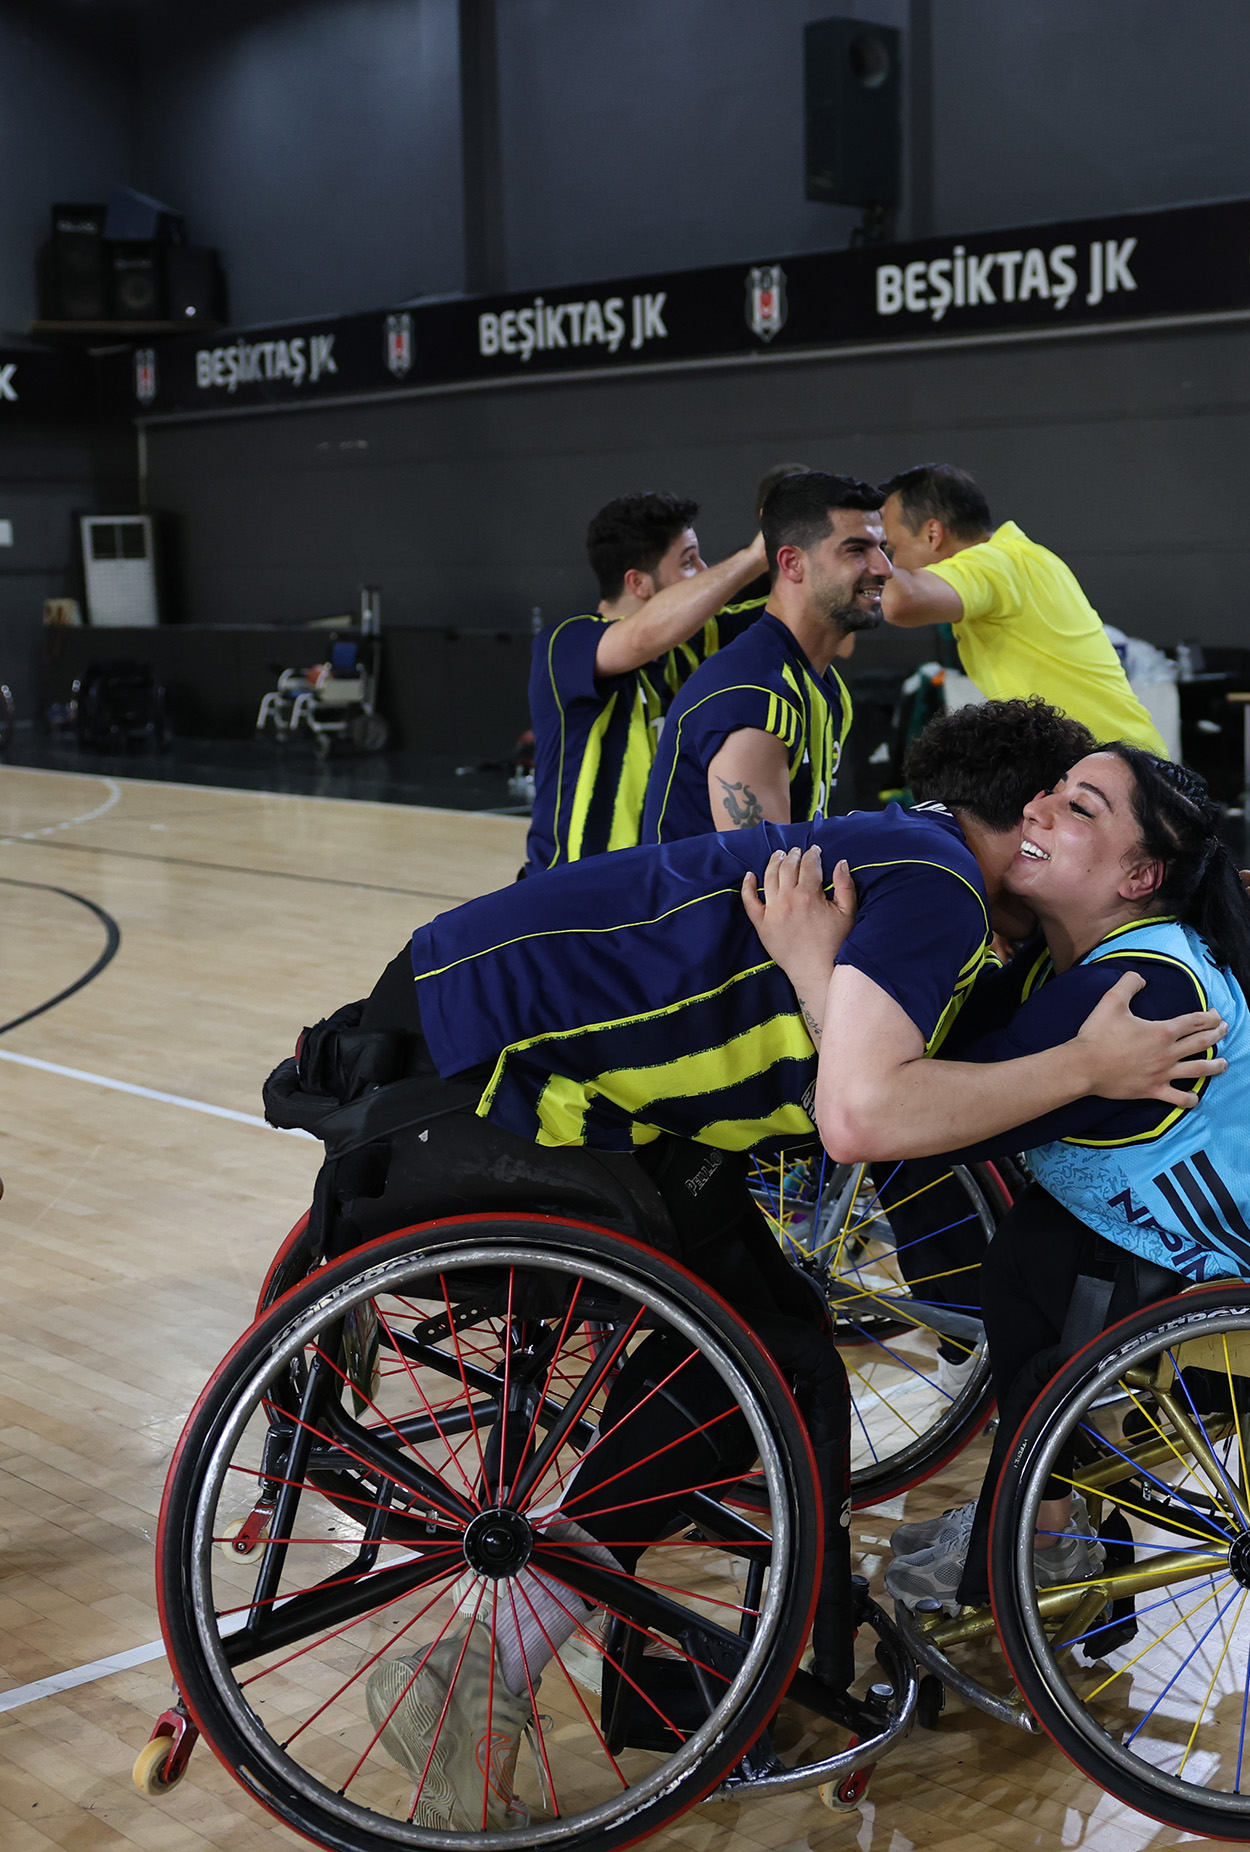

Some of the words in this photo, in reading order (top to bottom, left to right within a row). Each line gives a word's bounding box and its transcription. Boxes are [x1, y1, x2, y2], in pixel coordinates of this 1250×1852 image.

[876, 245, 1078, 322] BEŞİKTAŞ
[1086, 238, 1138, 304] JK
[479, 297, 626, 361] BEŞİKTAŞ
[632, 292, 669, 347] JK
[196, 338, 304, 392] BEŞİKTAŞ
[309, 334, 337, 383] JK
